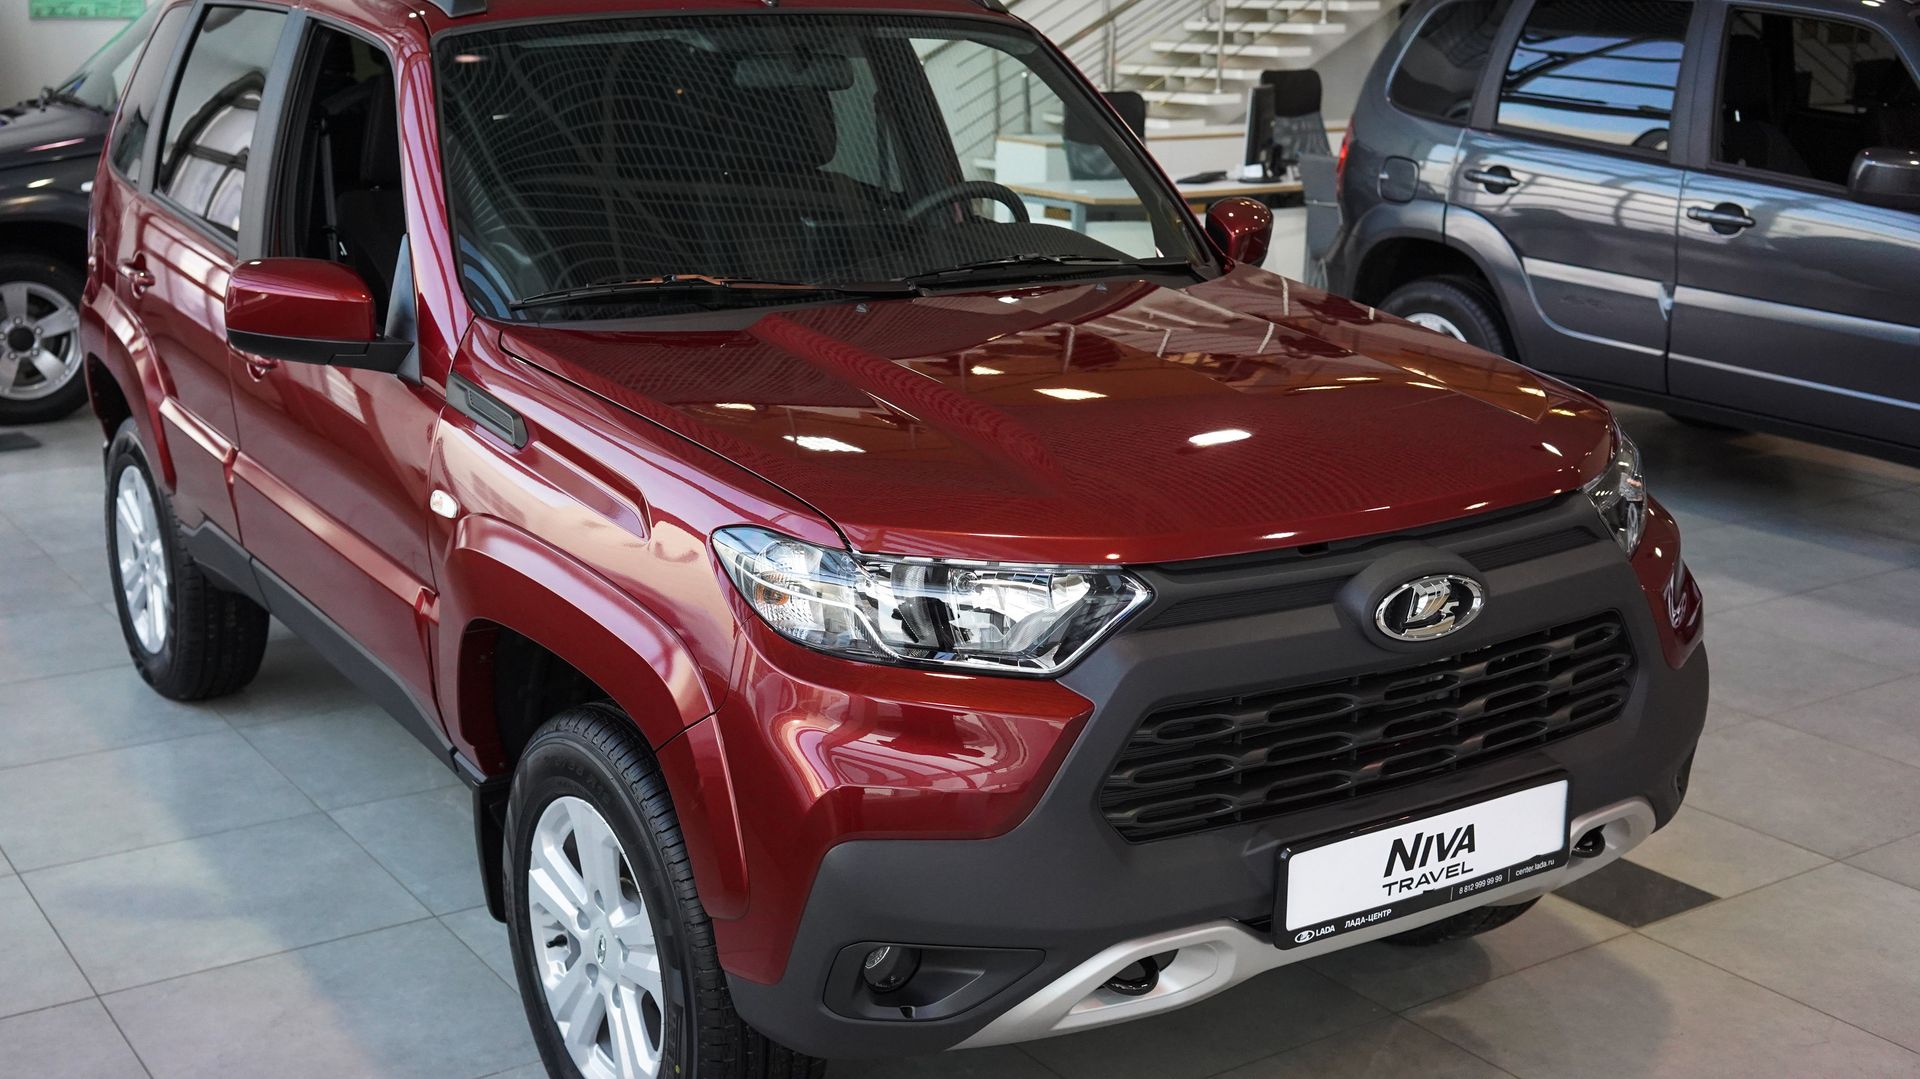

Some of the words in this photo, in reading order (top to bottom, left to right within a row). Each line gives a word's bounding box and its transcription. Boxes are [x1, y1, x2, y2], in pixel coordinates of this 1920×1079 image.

[1383, 823, 1475, 878] NIVA
[1515, 859, 1555, 876] center.lada.ru
[1382, 861, 1474, 896] TRAVEL
[1464, 883, 1474, 893] 812
[1475, 879, 1486, 890] 999
[1487, 877, 1494, 887] 99
[1495, 874, 1503, 884] 99
[1344, 908, 1392, 929] ЛАДА-ЦЕНТР
[1315, 924, 1336, 937] LADA
